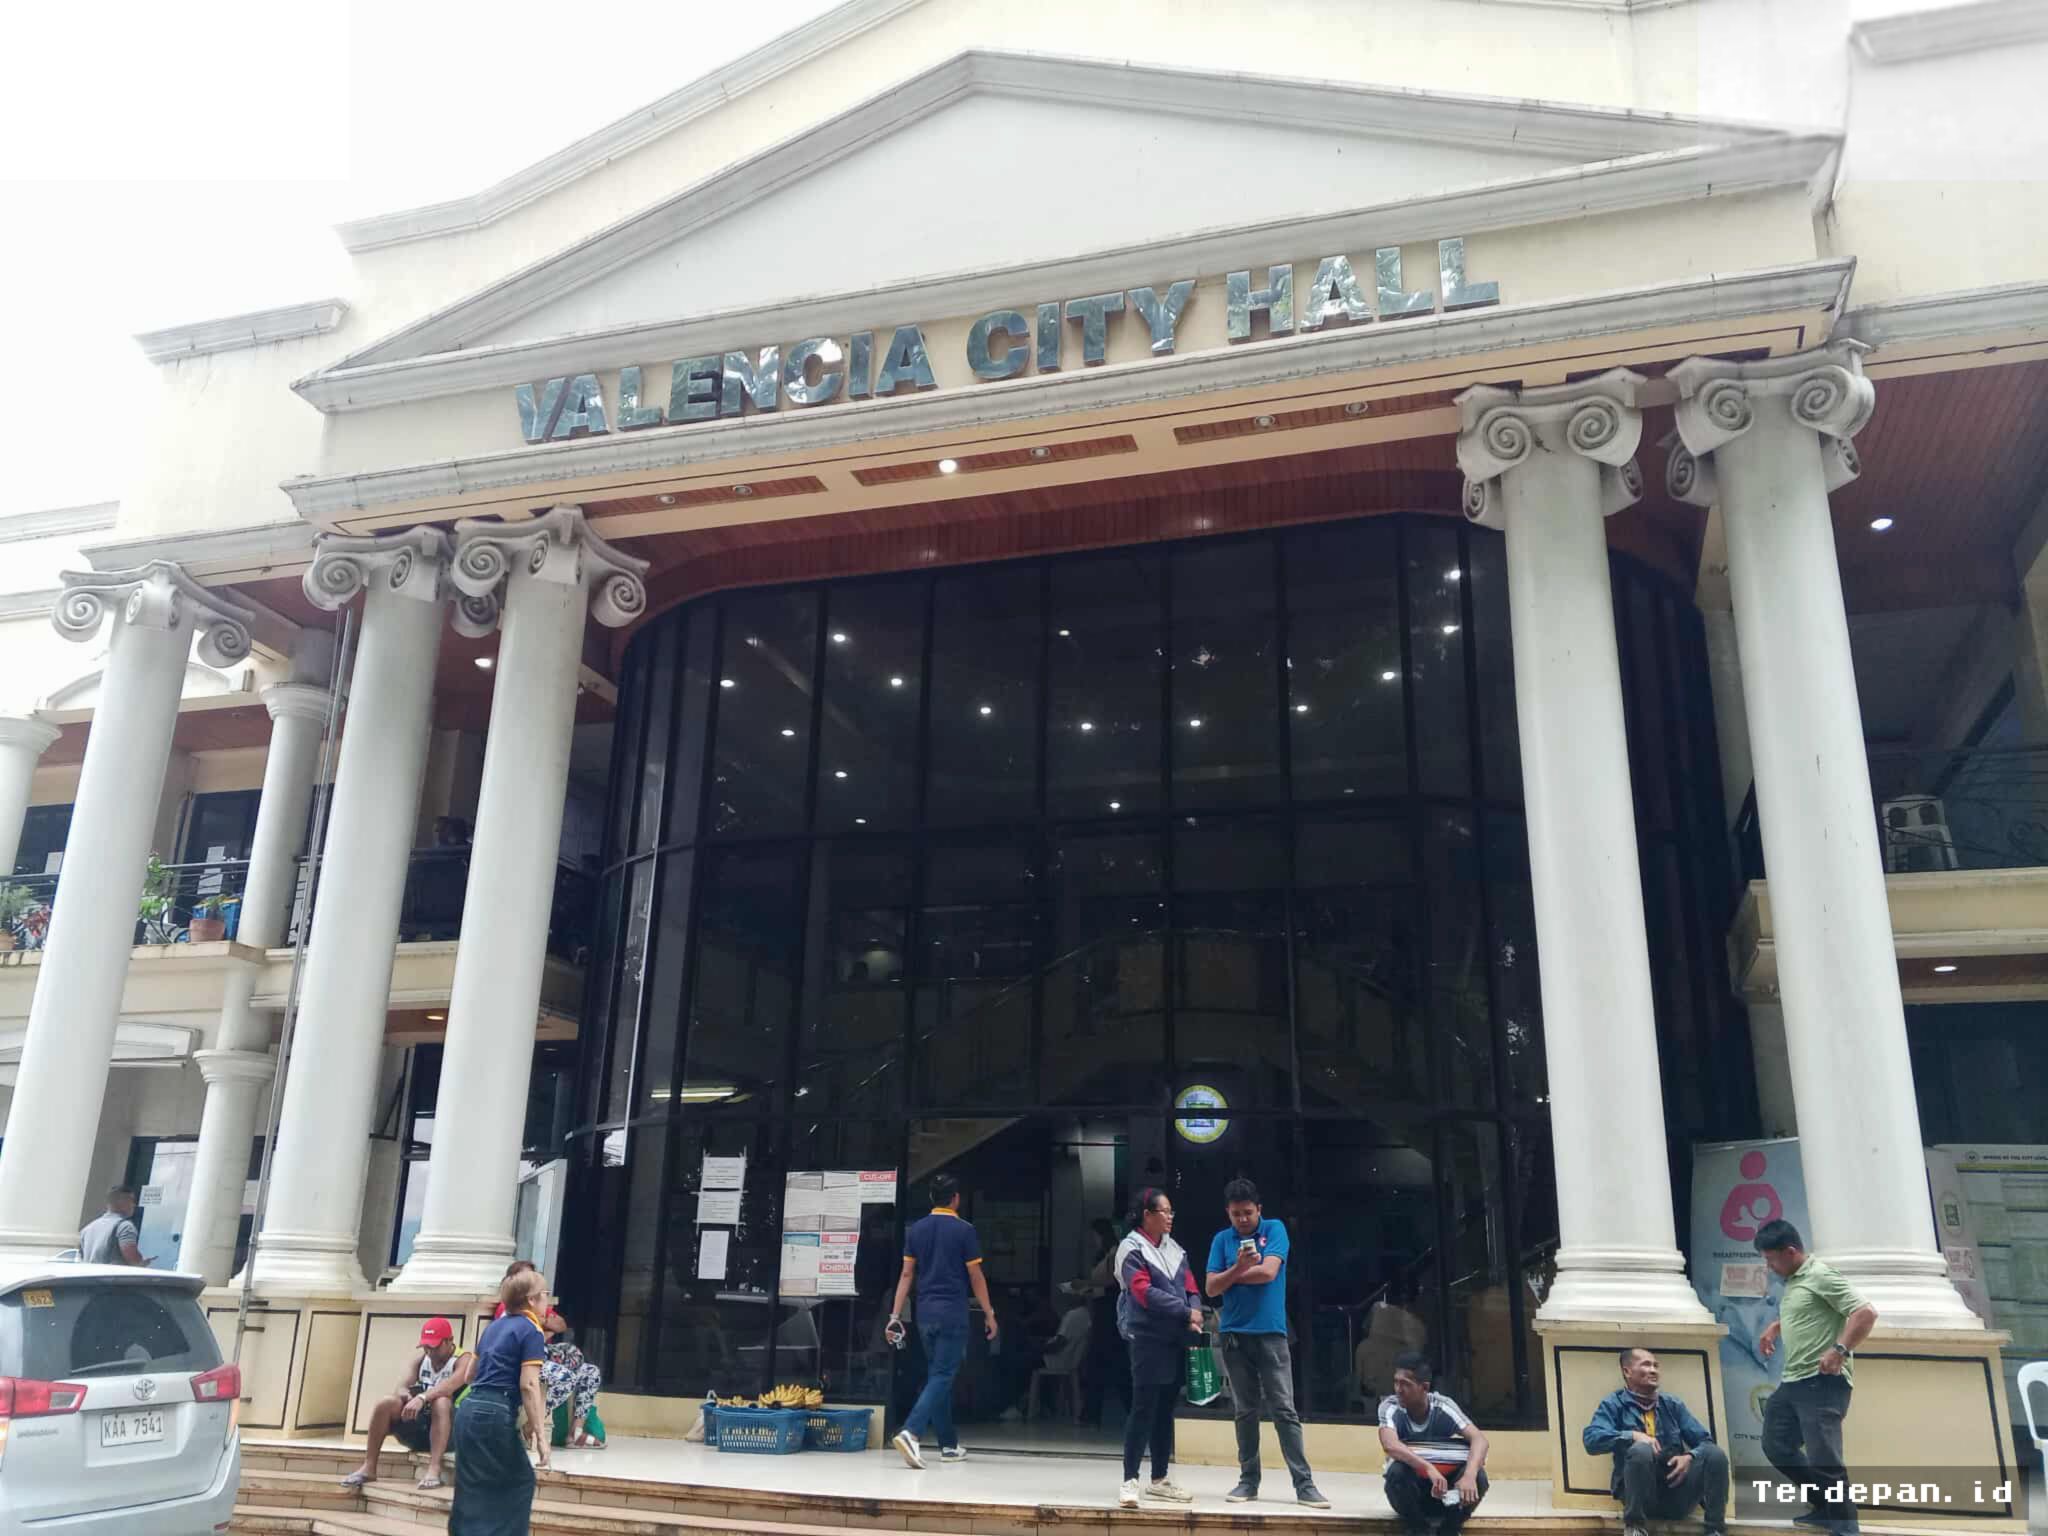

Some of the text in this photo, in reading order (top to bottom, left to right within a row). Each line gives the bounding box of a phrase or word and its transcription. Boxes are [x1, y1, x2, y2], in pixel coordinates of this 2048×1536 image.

[514, 237, 1500, 444] VALENCIA CITY HALL
[104, 1416, 162, 1439] KAA 7541
